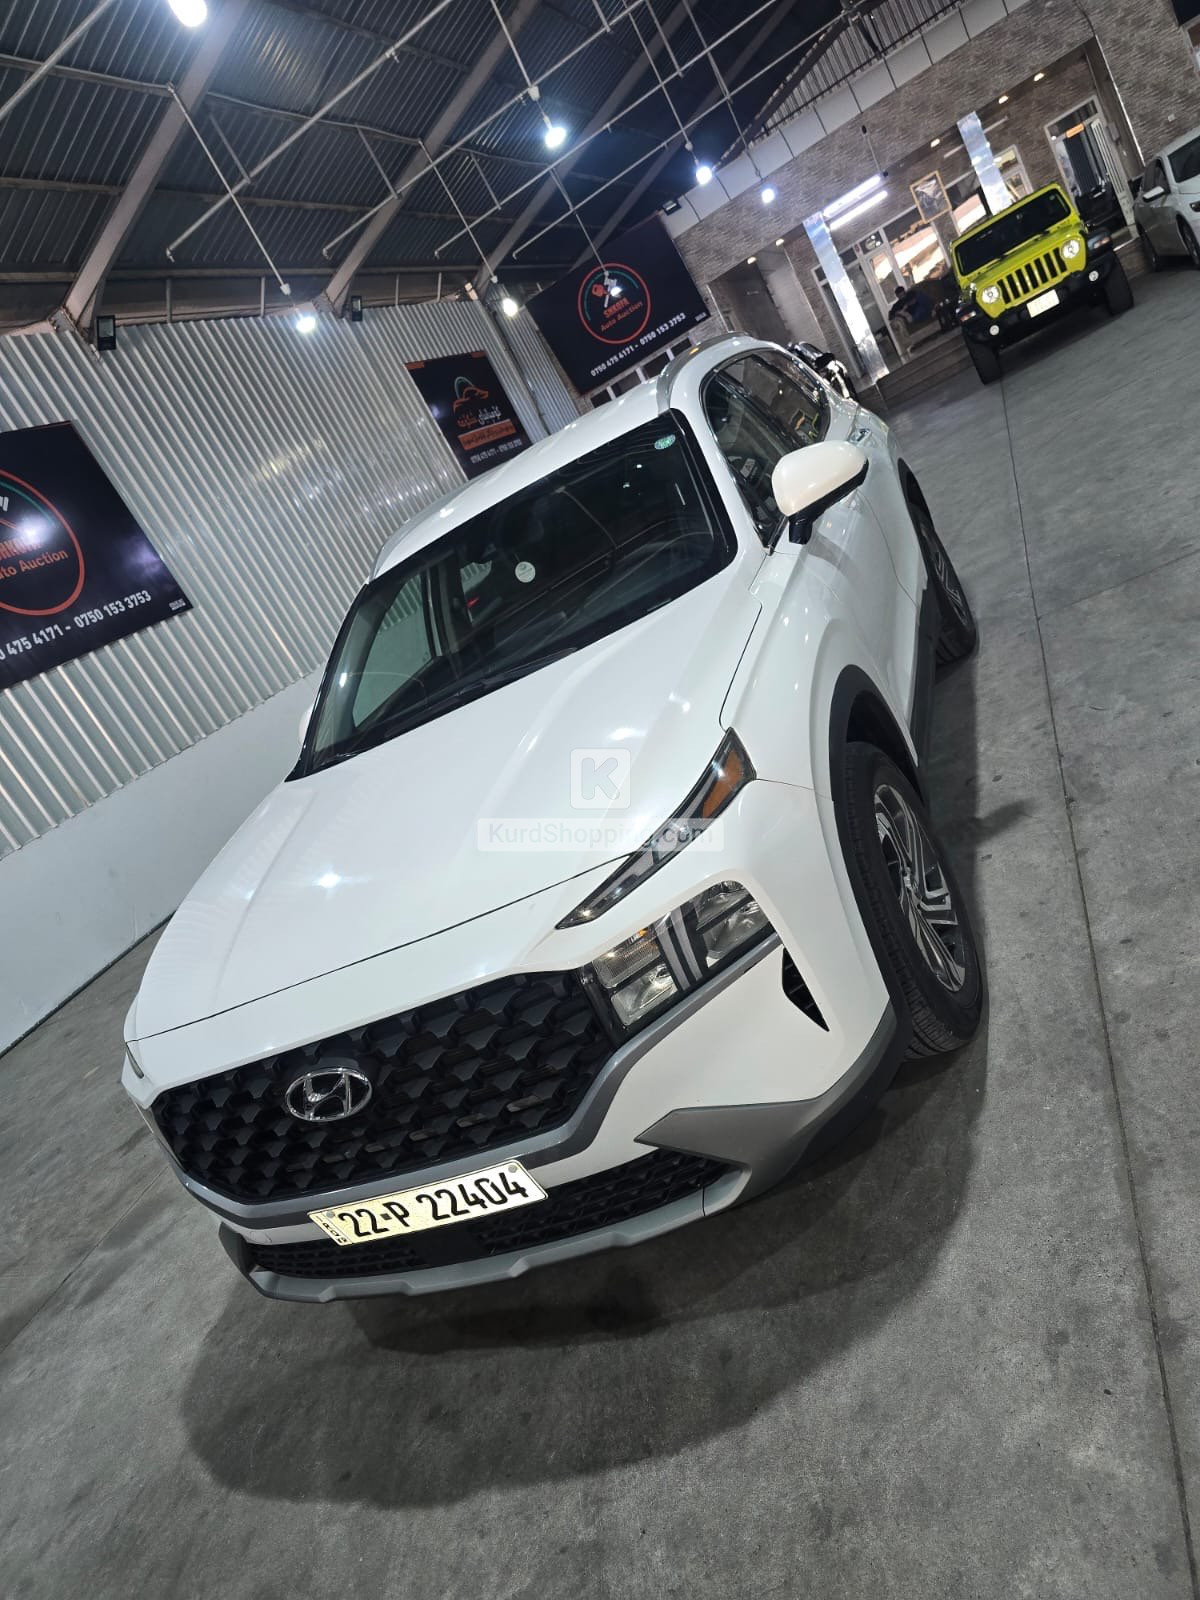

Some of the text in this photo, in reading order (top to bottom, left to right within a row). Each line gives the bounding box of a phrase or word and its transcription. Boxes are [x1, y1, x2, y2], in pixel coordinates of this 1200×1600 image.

[600, 301, 643, 332] Auto Auction
[590, 363, 607, 377] 0750
[606, 354, 620, 367] 475
[619, 345, 635, 359] 4171
[639, 331, 657, 345] 0750
[656, 323, 670, 335] 153
[670, 312, 686, 327] 3753
[18, 550, 69, 572] Auction
[6, 636, 32, 655] 475
[32, 623, 64, 645] 4171
[73, 609, 104, 629] 0750
[103, 602, 126, 617] 153
[124, 590, 152, 609] 3753
[415, 1172, 529, 1220] 22404
